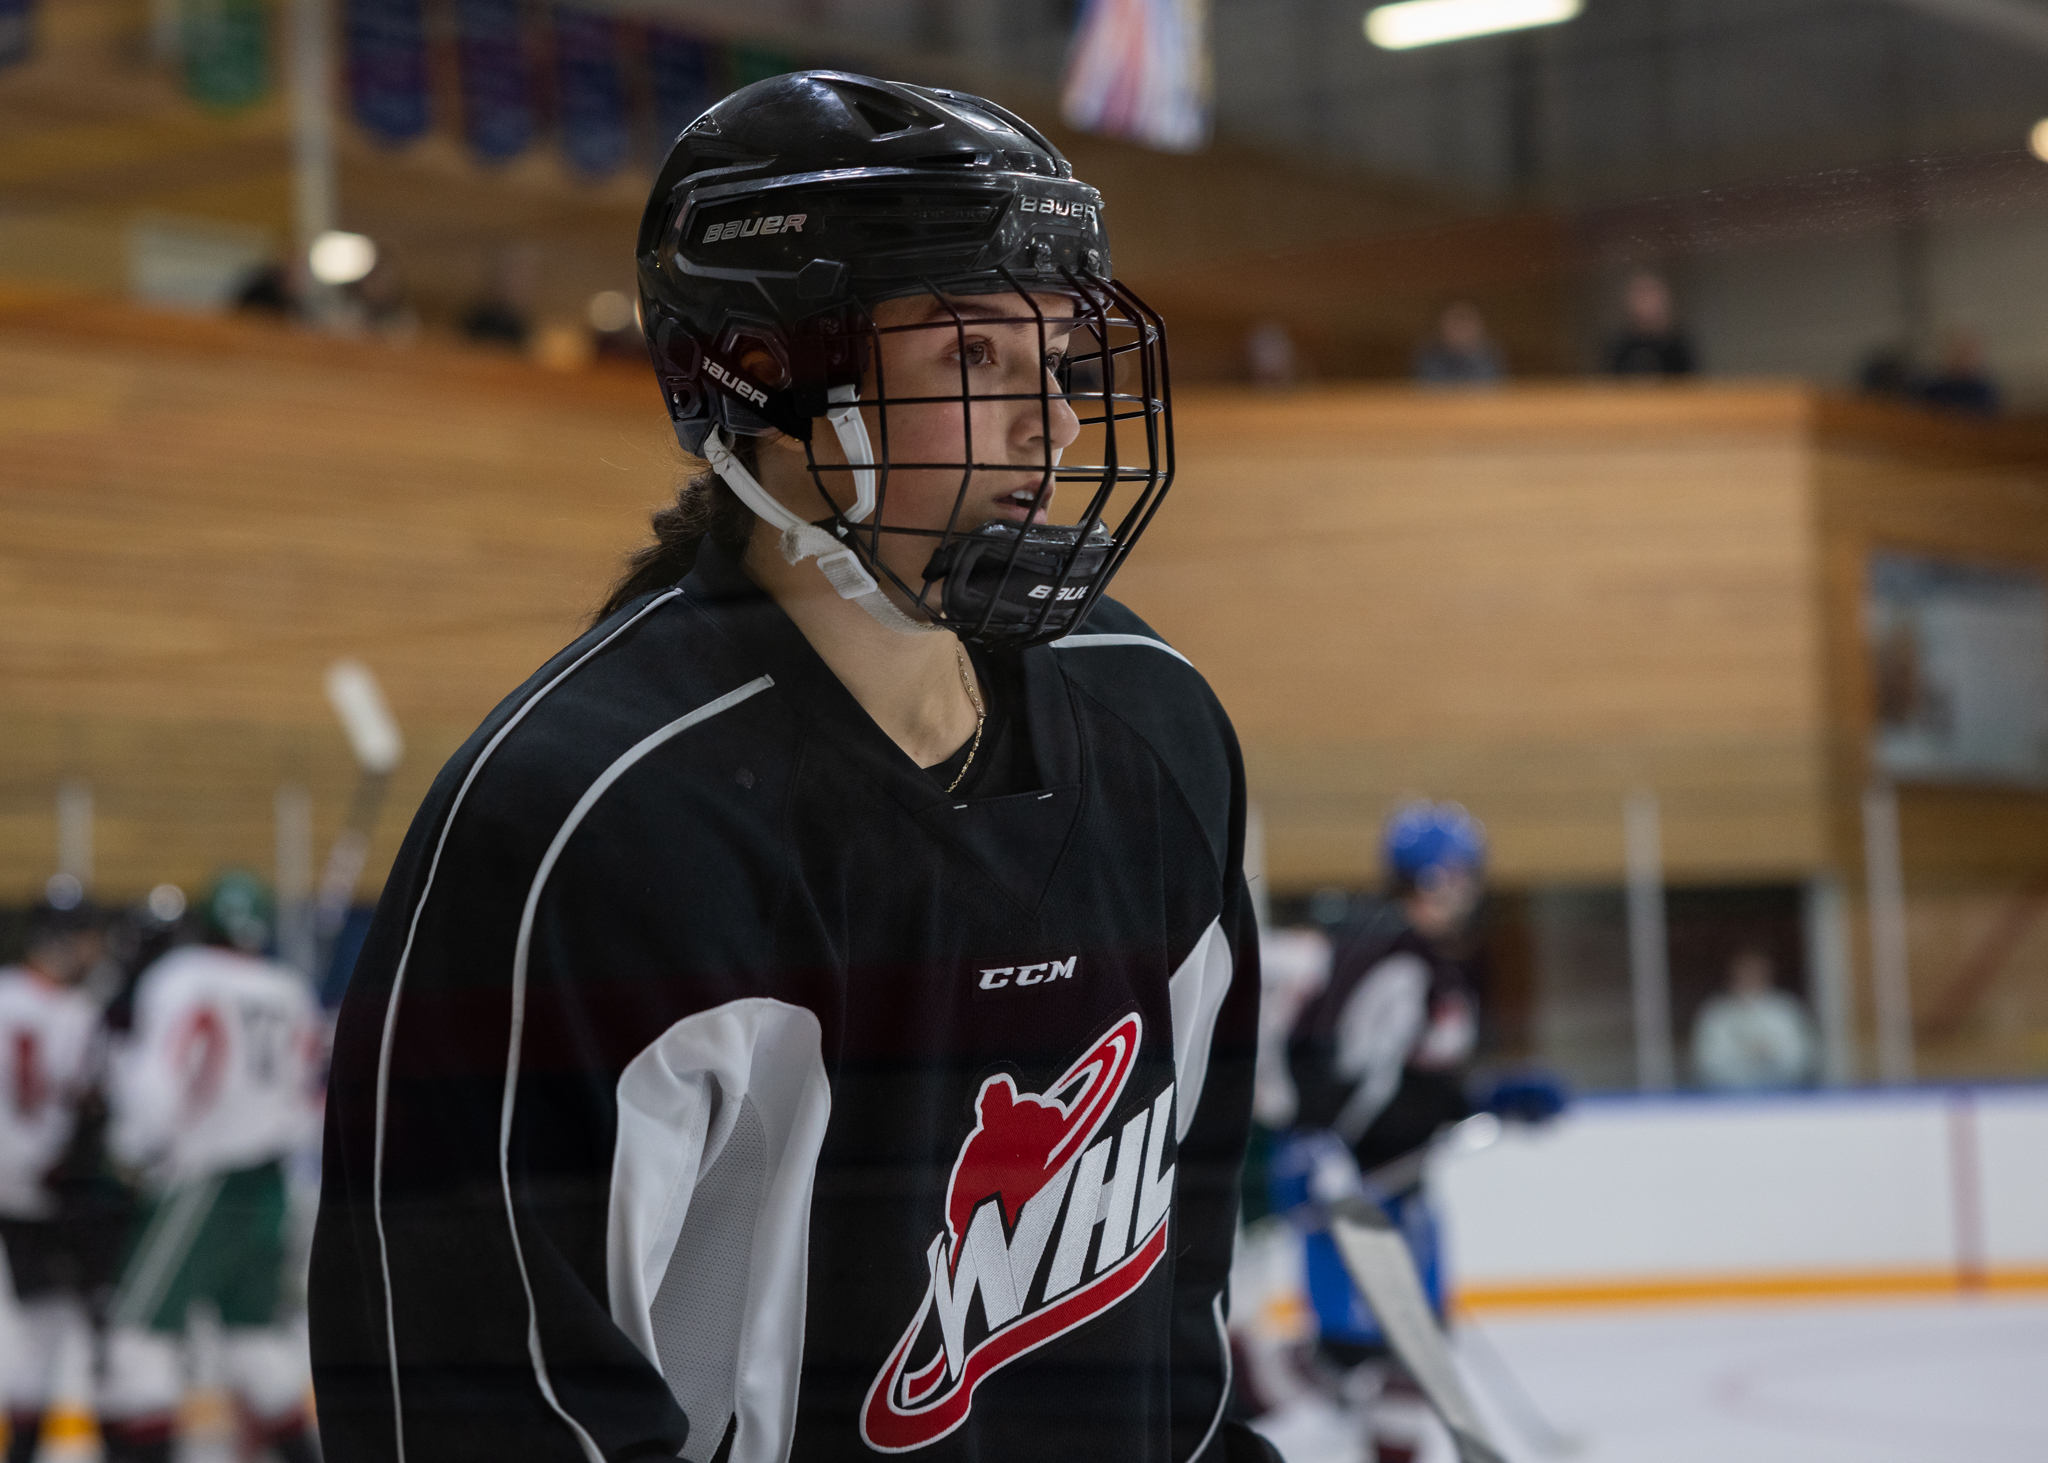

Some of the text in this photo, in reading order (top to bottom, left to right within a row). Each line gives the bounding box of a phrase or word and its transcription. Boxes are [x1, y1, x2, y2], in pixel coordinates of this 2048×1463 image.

[702, 214, 807, 243] BAUER
[979, 956, 1077, 990] CCM
[934, 1082, 1175, 1383] WHL
